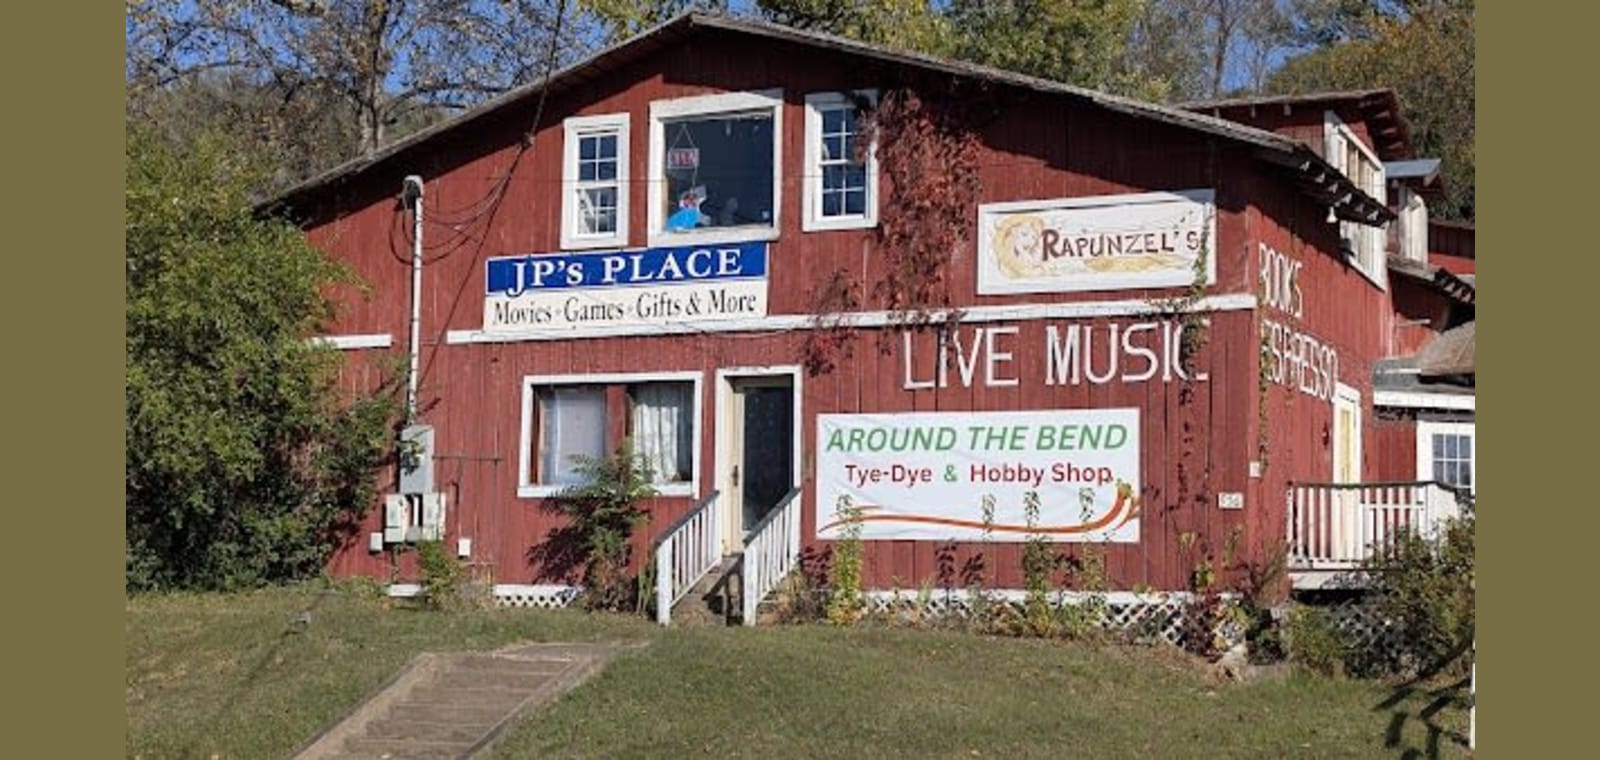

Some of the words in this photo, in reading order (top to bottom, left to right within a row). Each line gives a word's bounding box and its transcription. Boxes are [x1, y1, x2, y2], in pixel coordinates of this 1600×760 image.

[505, 260, 584, 297] JP's
[600, 248, 743, 283] PLACE
[492, 300, 553, 325] Movies
[564, 296, 624, 322] Games
[636, 291, 681, 318] Gifts
[685, 291, 702, 316] &
[707, 288, 757, 314] More
[903, 325, 1019, 389] LIVE
[826, 426, 957, 452] AROUND
[968, 425, 1028, 451] THE
[1035, 424, 1128, 450] BEND
[845, 464, 932, 487] Tye-Dye
[944, 465, 958, 483] &
[970, 463, 1044, 486] Hobby
[1051, 463, 1113, 486] Shop
